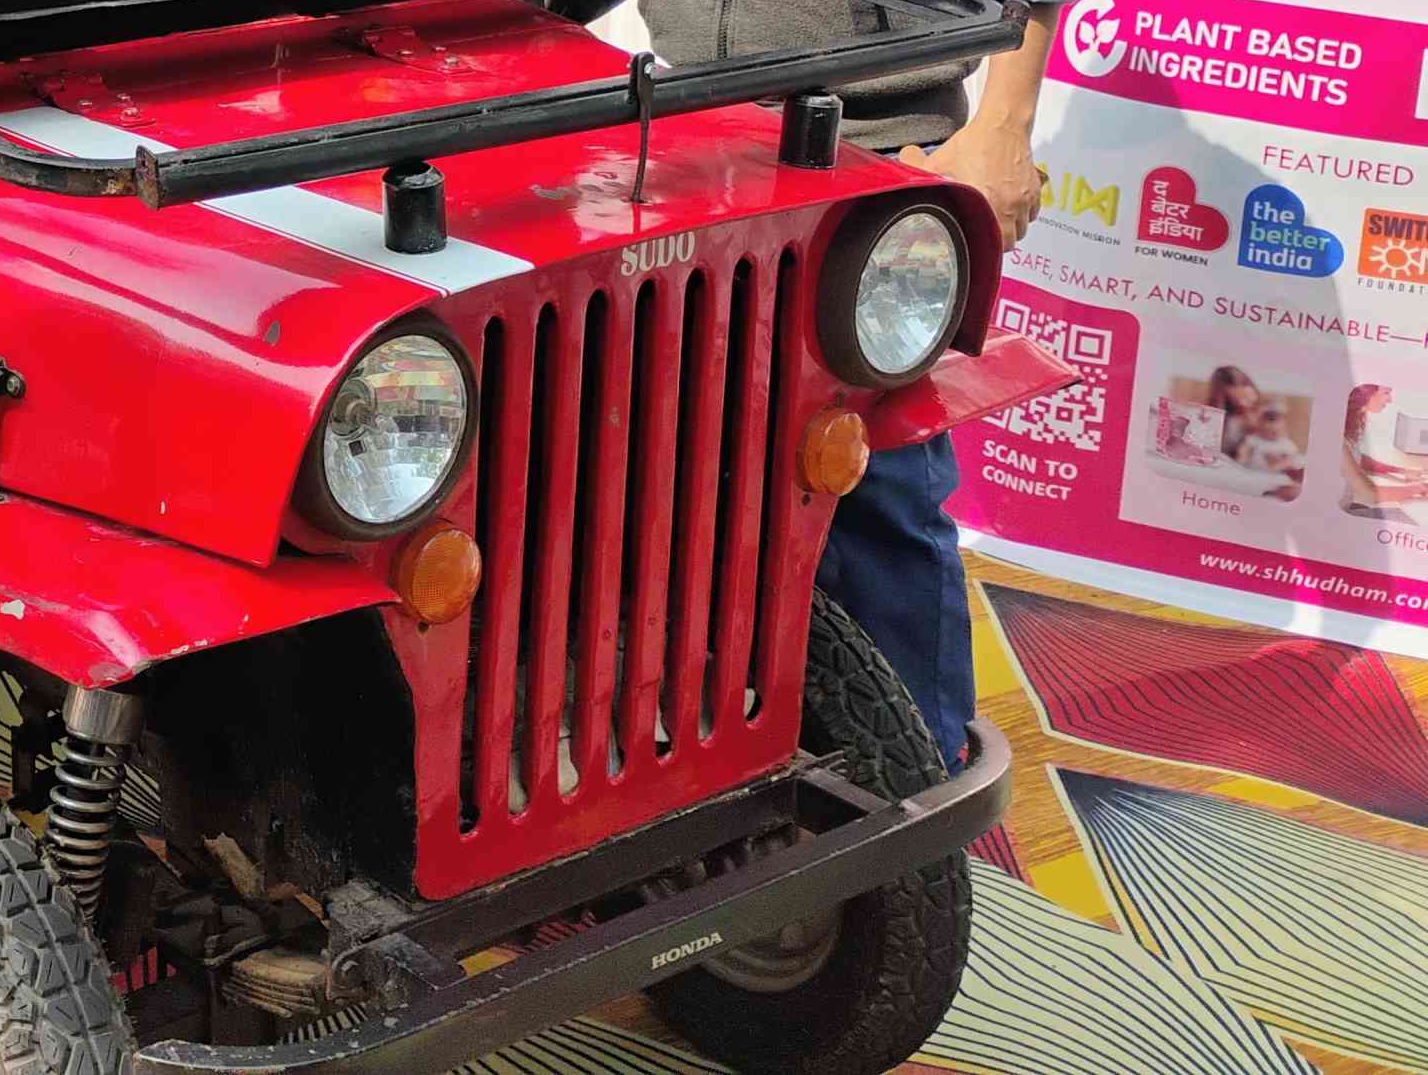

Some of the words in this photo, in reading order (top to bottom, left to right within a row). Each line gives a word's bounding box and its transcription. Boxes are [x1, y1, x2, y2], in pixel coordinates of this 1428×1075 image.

[1135, 10, 1241, 51] PLANT
[1247, 28, 1363, 71] BASED
[1128, 45, 1349, 106] INGREDIENTS
[1262, 145, 1414, 186] FEATURED
[1252, 201, 1296, 225] the
[1249, 221, 1331, 251] better
[1134, 245, 1159, 257] FOR
[1161, 249, 1209, 267] WOMEN
[1247, 243, 1314, 271] india
[1010, 247, 1054, 280] SAFE,
[1059, 265, 1138, 302] SMART,
[1147, 284, 1206, 309] AND
[982, 439, 1037, 474] SCAN
[1044, 459, 1079, 480] TO
[982, 465, 1072, 501] CONNECT
[1181, 490, 1242, 517] Home
[651, 932, 724, 971] HONDA
